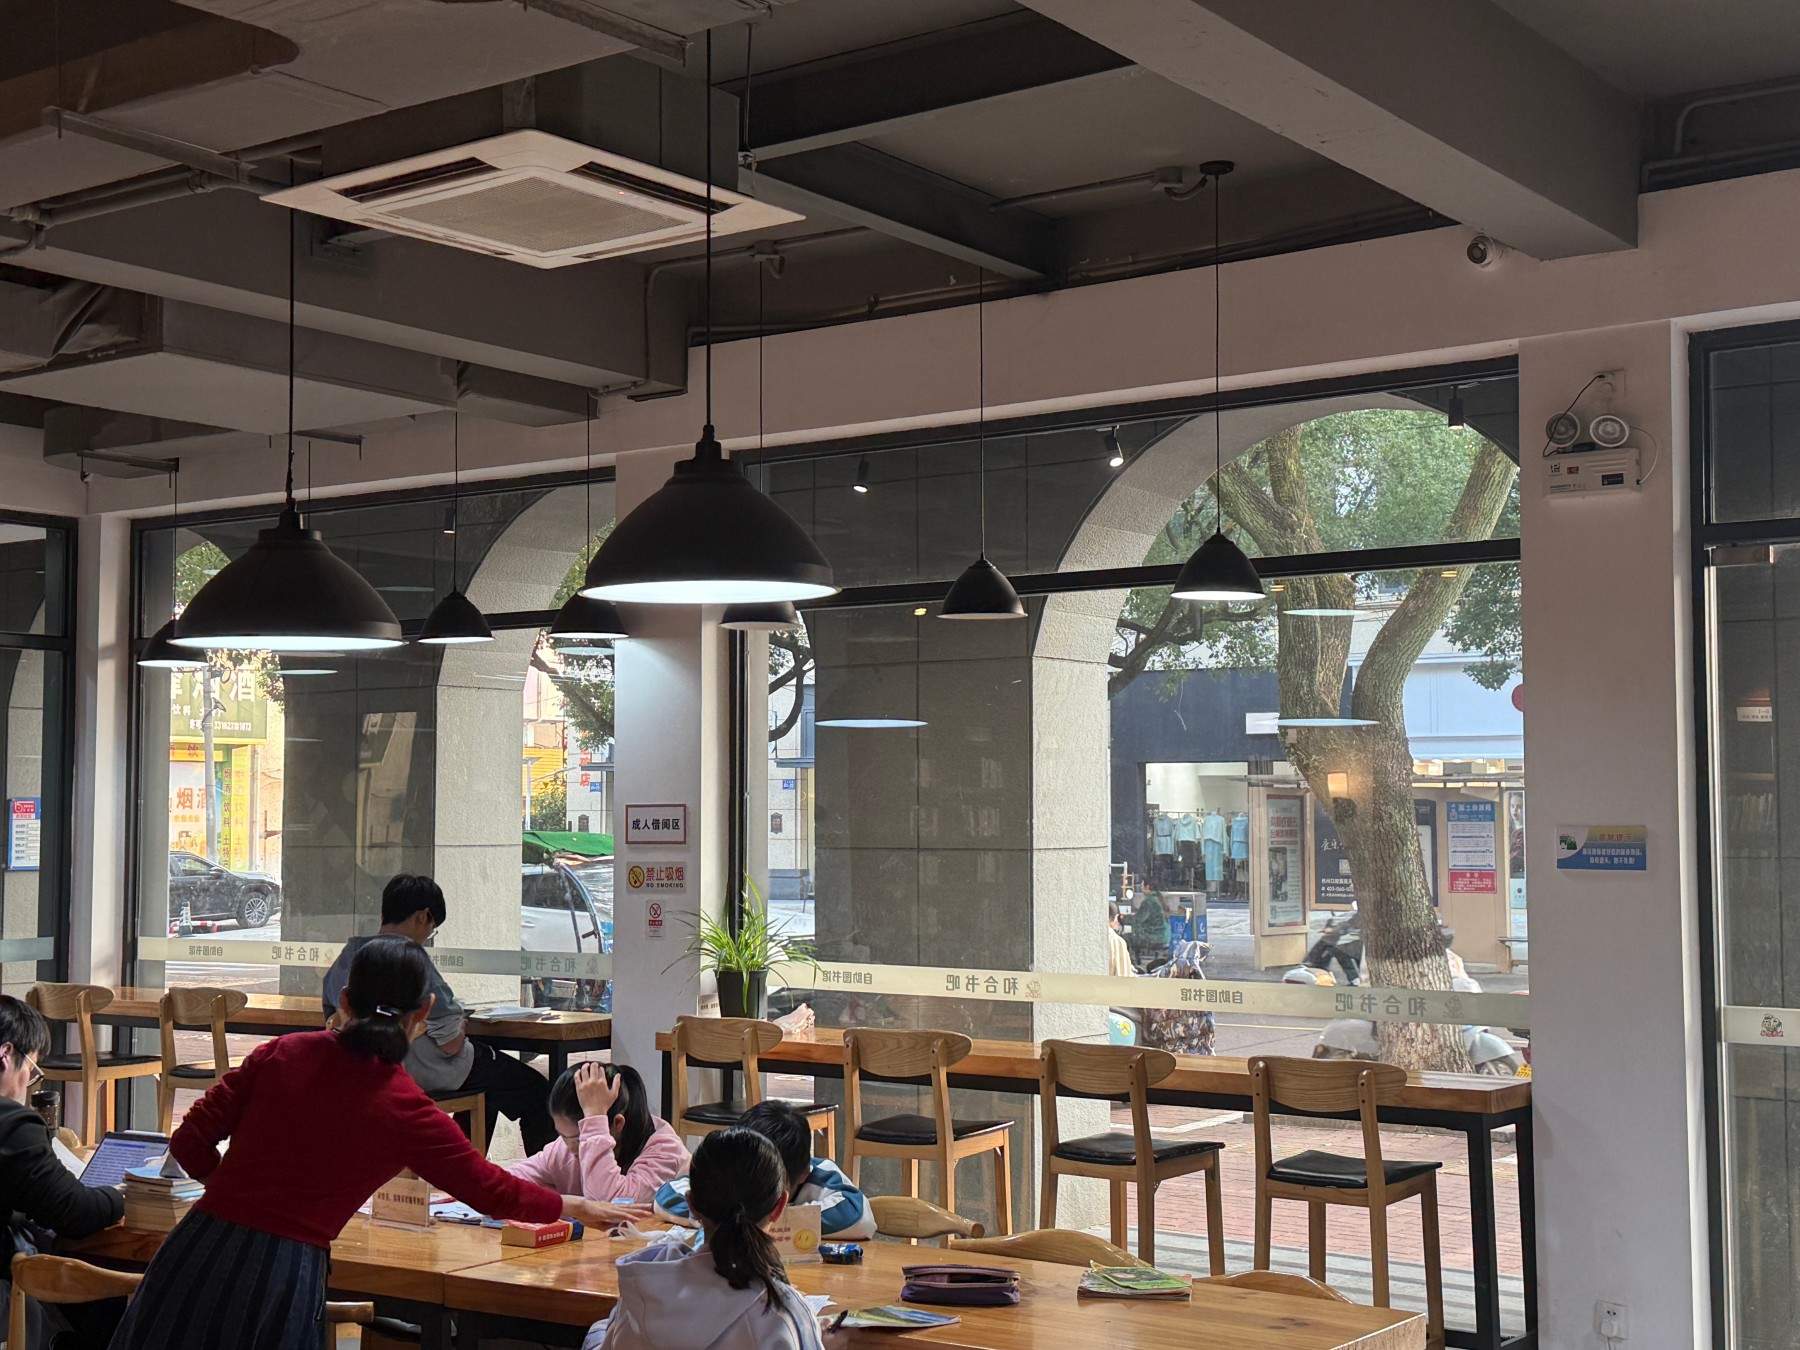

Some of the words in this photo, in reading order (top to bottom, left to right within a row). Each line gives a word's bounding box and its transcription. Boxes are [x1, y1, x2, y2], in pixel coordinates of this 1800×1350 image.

[632, 818, 680, 831] 成人借阅区
[645, 866, 684, 881] 禁止吸烟
